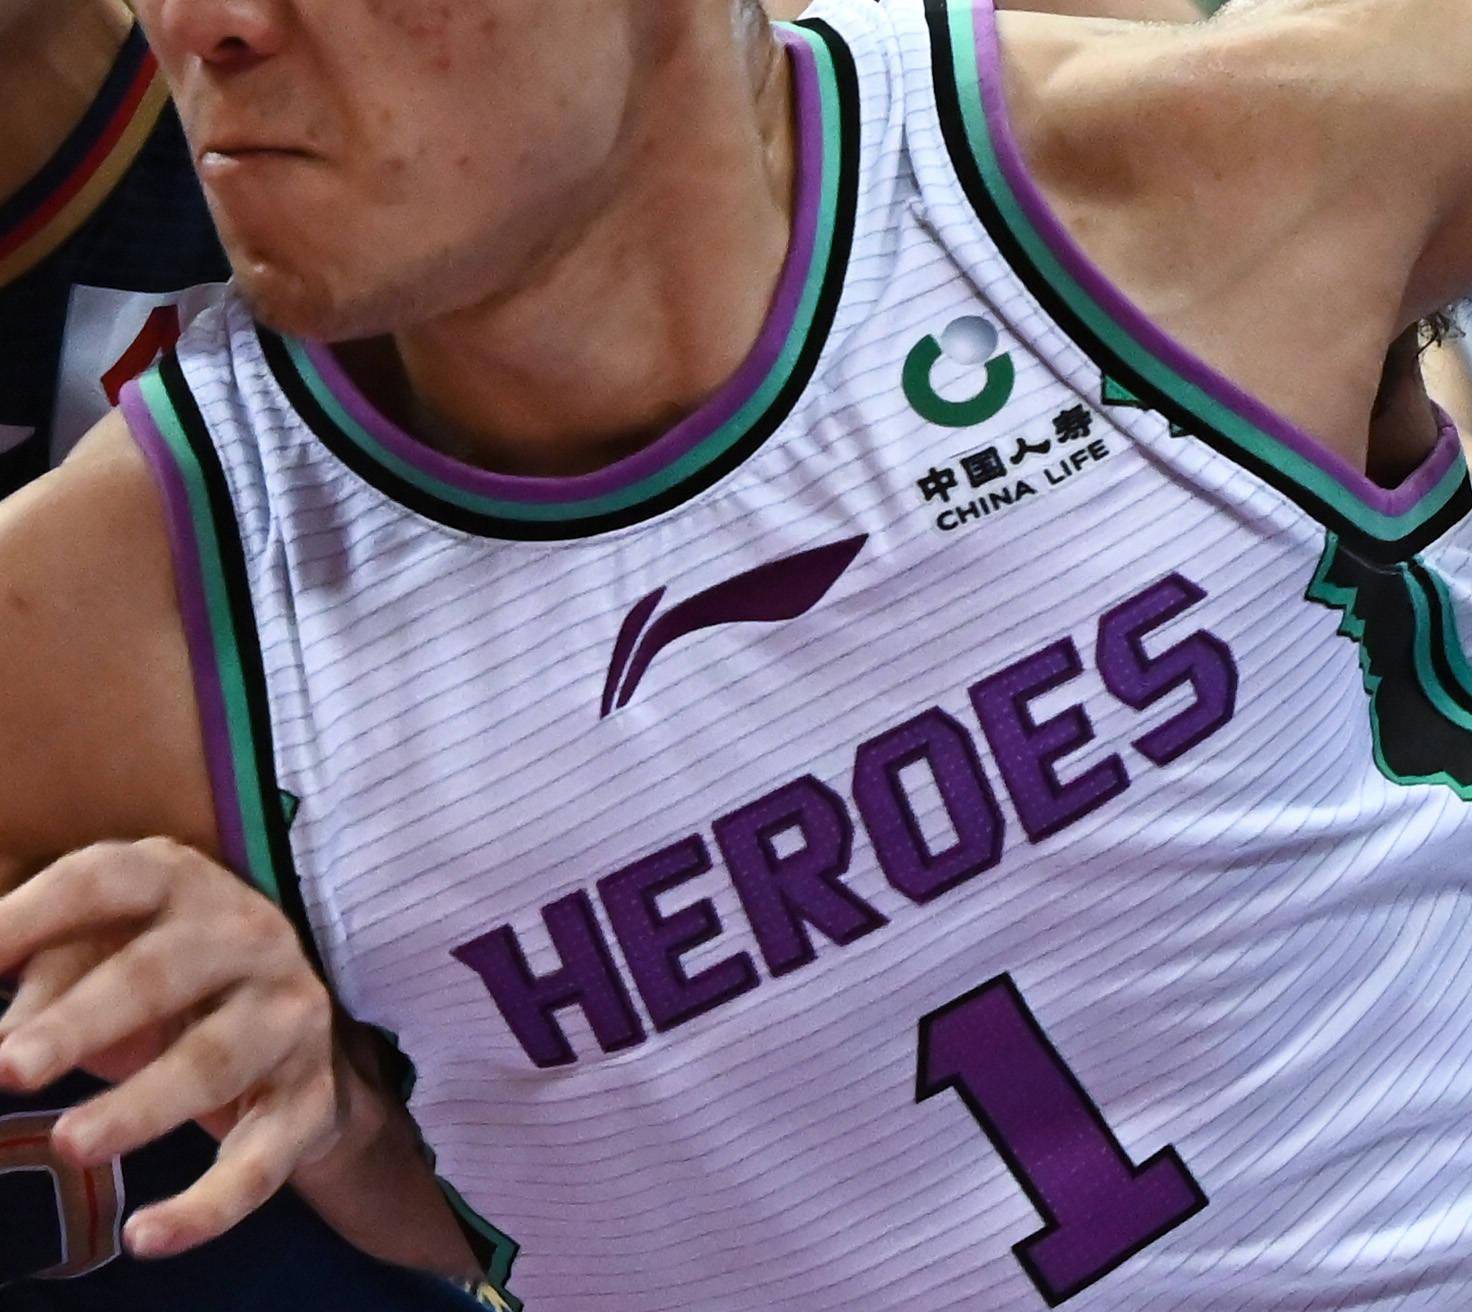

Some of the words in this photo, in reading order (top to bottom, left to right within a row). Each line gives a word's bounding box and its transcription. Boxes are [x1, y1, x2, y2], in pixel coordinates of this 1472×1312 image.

[916, 403, 1094, 503] 中国人寿
[936, 480, 1038, 531] CHINA
[1042, 438, 1111, 486] LIFE
[450, 569, 1240, 1069] HEROES
[915, 971, 1210, 1309] 1
